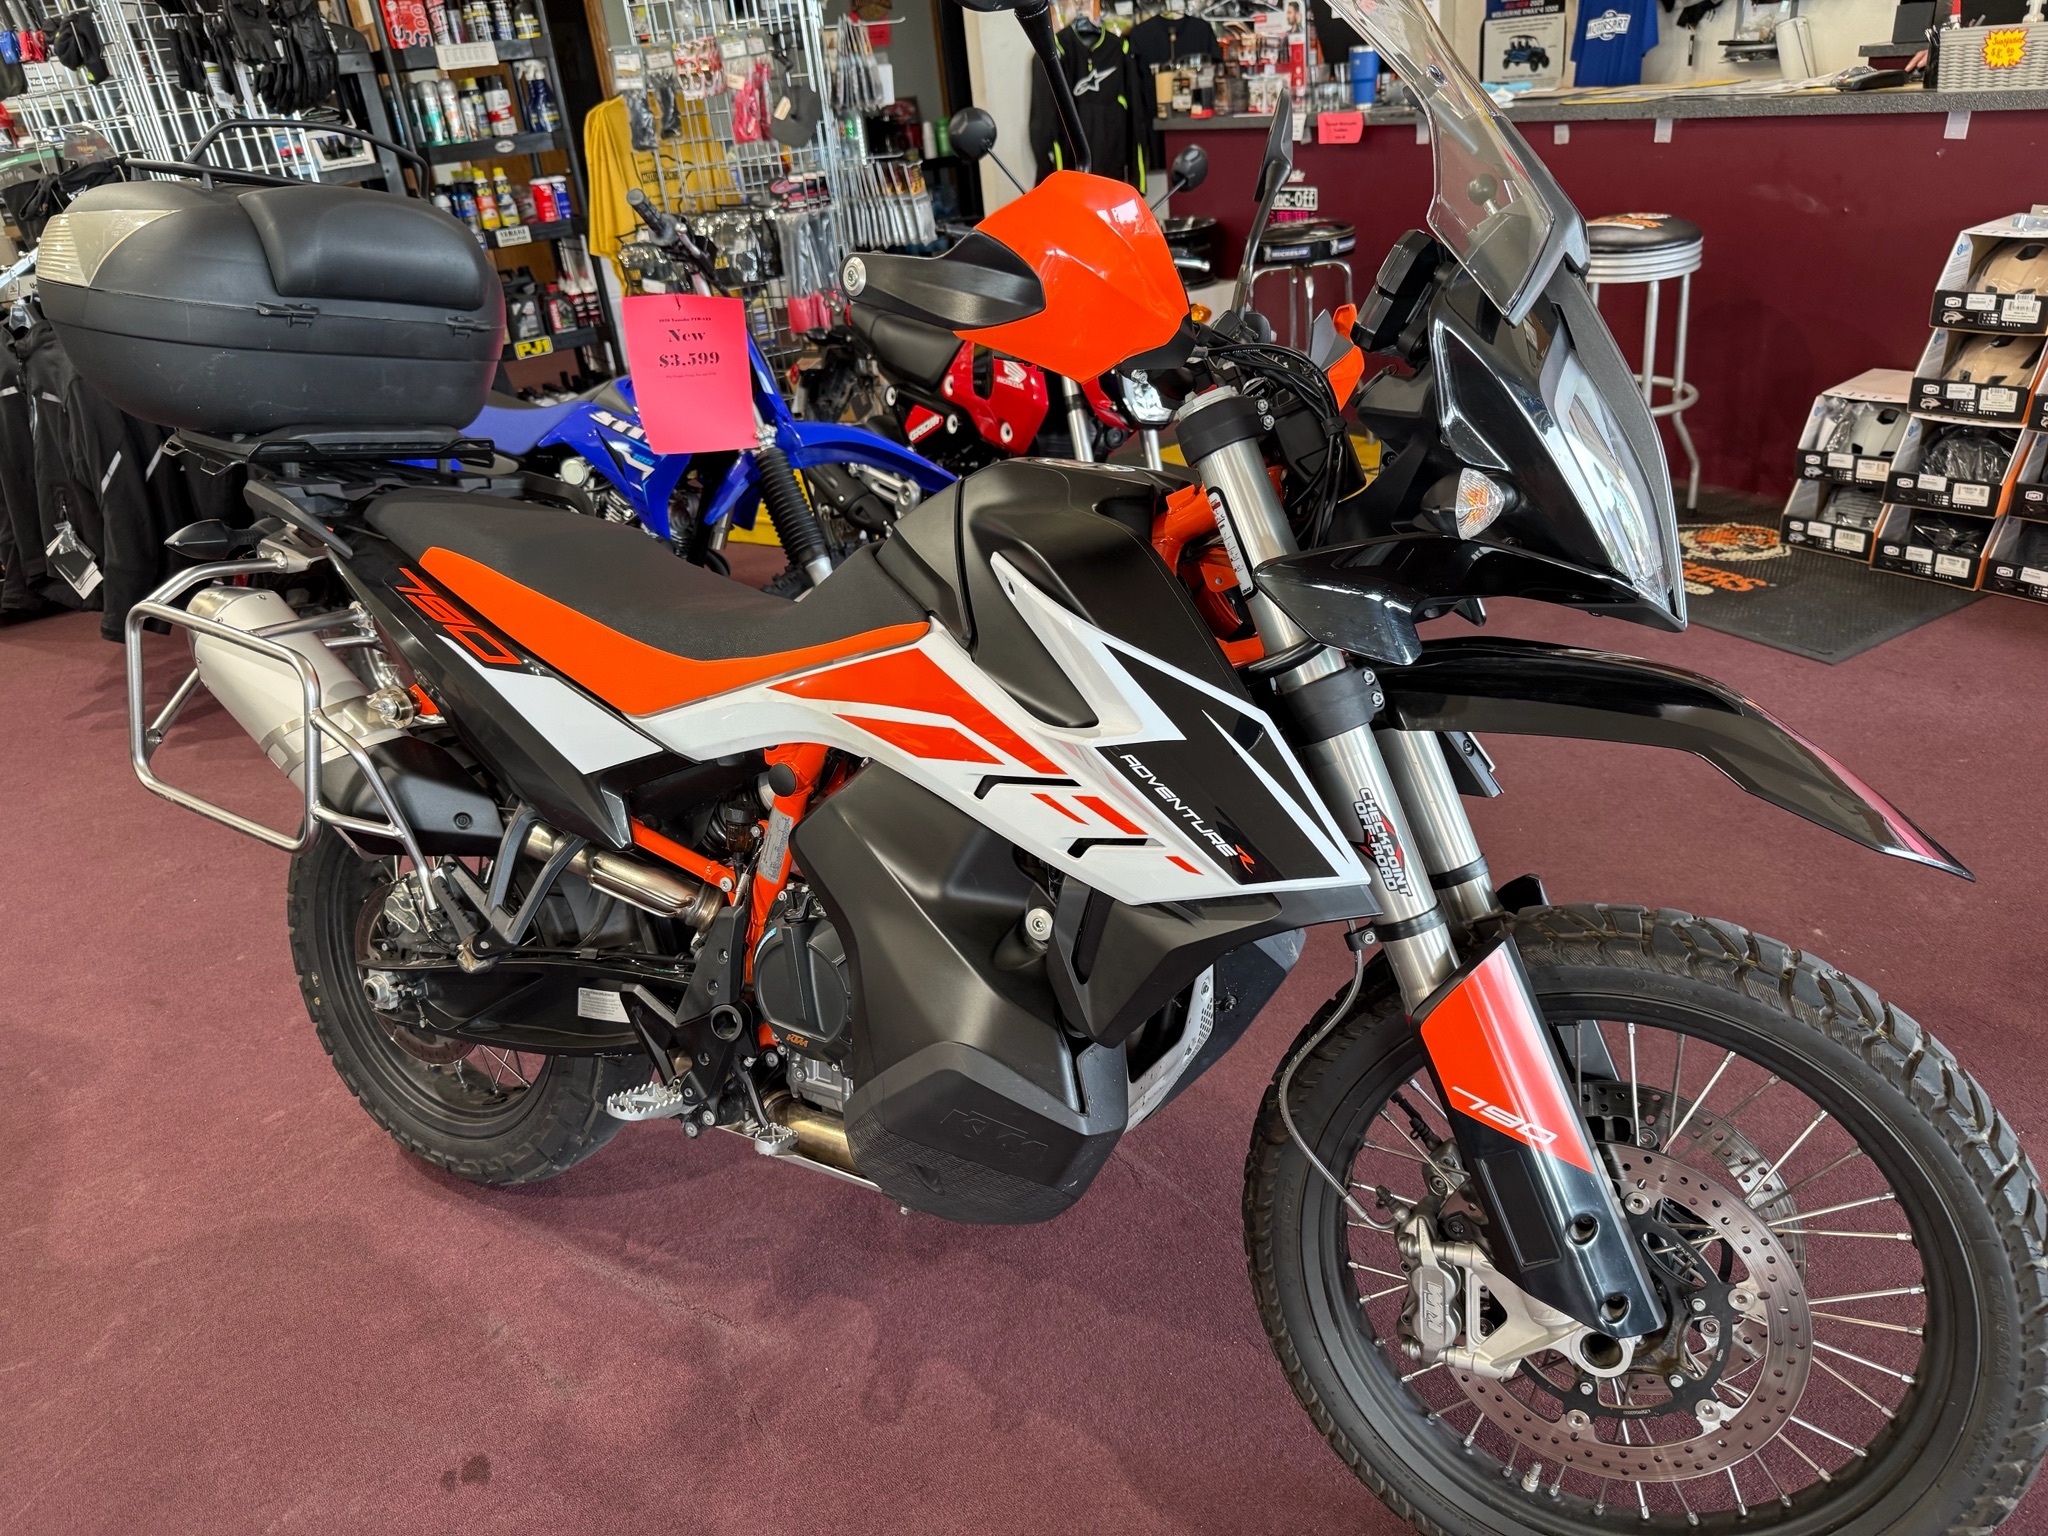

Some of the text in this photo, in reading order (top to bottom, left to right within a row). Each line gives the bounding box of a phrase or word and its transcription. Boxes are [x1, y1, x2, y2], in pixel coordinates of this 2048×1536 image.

[517, 339, 551, 358] PJ1
[668, 328, 706, 343] New
[996, 375, 1025, 390] HONDA
[395, 567, 522, 665] 790
[1119, 754, 1239, 858] ADVENTURE
[1353, 801, 1398, 892] OFF-ROAD
[1360, 787, 1413, 897] CHECKPOINT
[786, 1034, 809, 1047] KTM
[1451, 1085, 1558, 1145] 790
[1421, 1281, 1444, 1335] KTM
